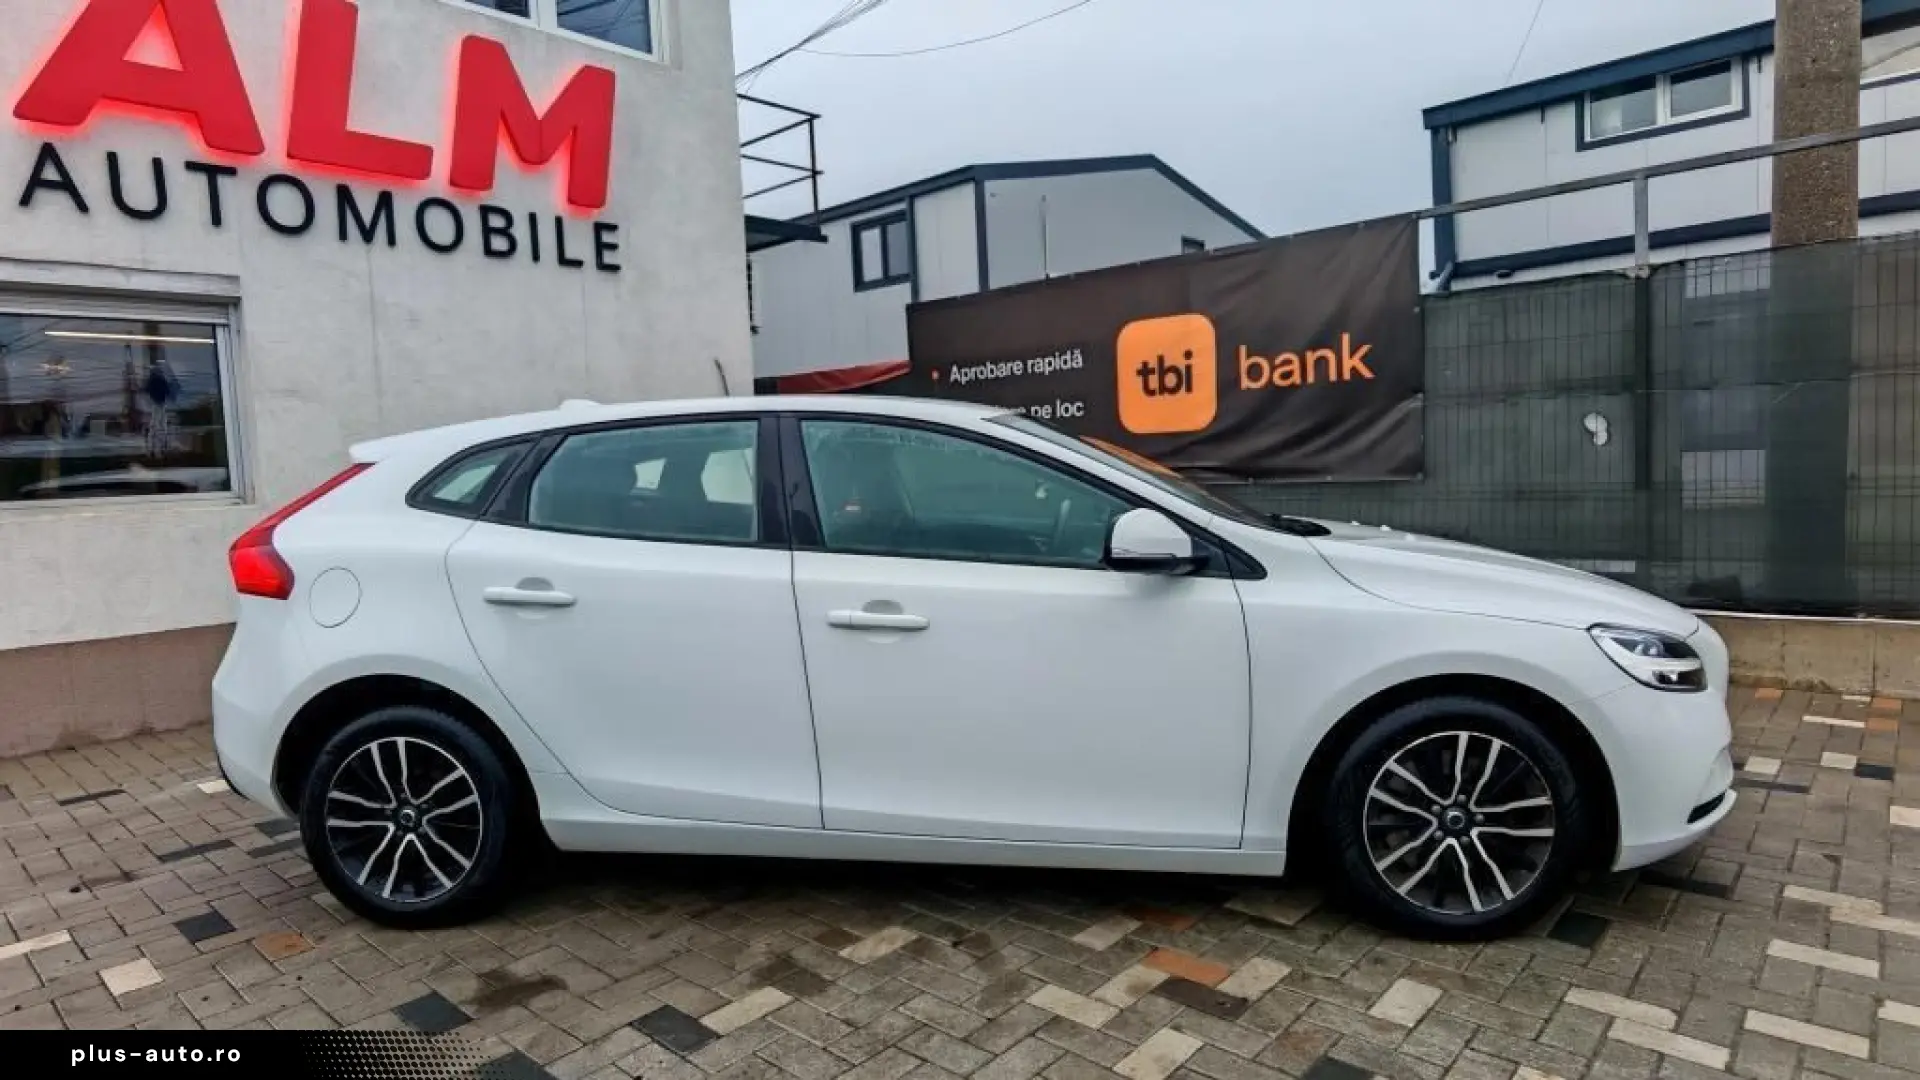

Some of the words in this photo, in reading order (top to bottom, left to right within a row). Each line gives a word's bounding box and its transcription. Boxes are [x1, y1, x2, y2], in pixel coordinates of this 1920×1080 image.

[12, 0, 616, 209] ALM
[18, 142, 622, 273] AUTOMOBILE
[949, 359, 1023, 385] Aprobare
[1027, 348, 1083, 375] rapidă
[1136, 349, 1193, 398] tbi
[1238, 332, 1376, 391] bank
[1056, 398, 1085, 418] loc
